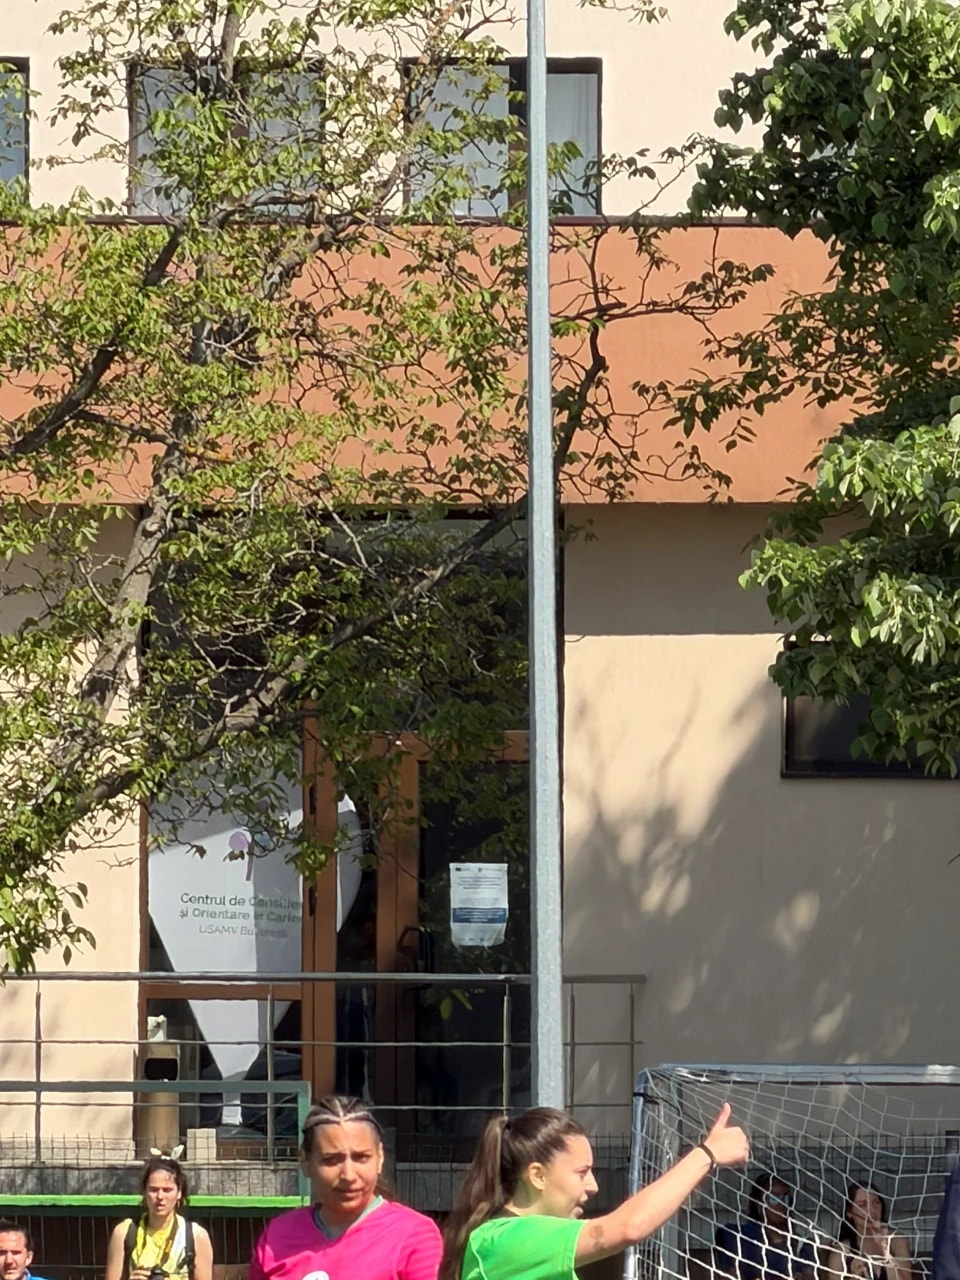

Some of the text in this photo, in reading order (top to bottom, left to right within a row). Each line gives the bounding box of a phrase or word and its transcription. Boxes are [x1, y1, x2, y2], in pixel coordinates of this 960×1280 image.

[180, 892, 226, 906] Centrul
[229, 895, 246, 907] de
[192, 908, 250, 920] Orientare
